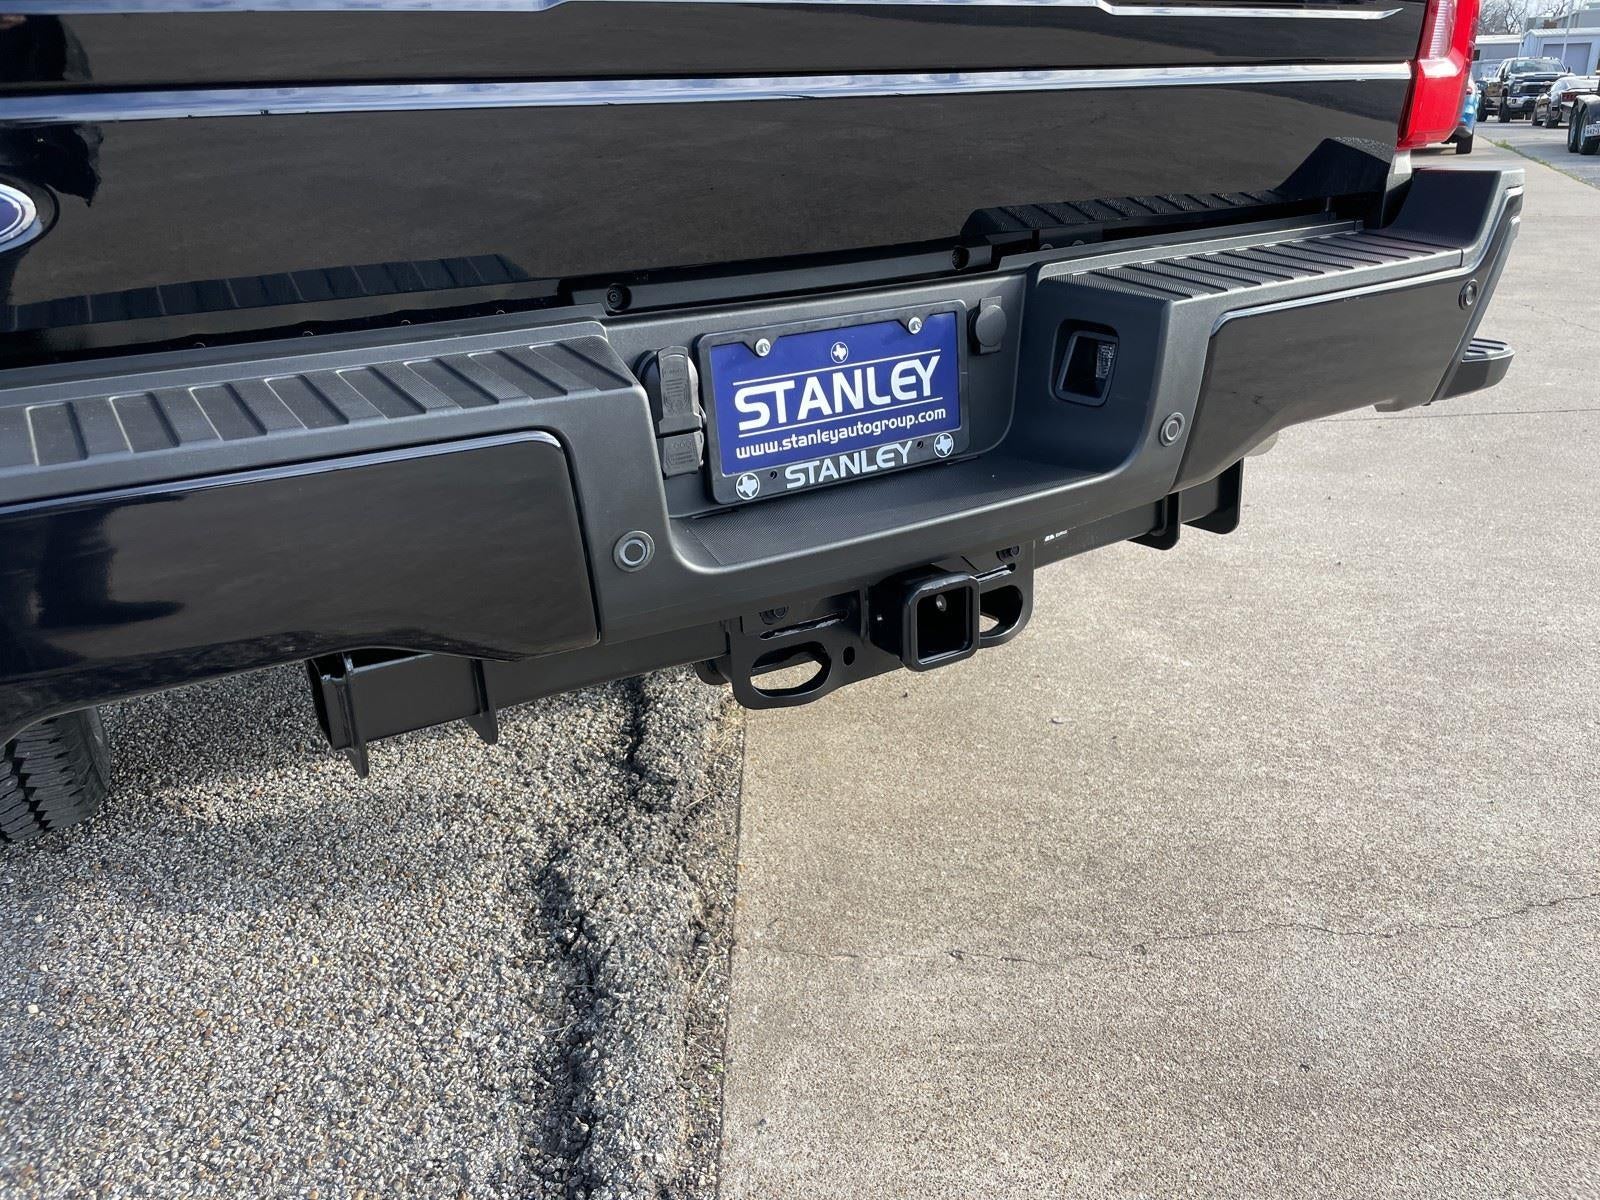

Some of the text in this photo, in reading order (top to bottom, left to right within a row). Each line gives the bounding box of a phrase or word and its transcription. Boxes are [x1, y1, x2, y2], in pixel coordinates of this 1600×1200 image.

[734, 355, 940, 431] STANLEY
[736, 408, 946, 459] www.stanleyautogroup.com
[784, 441, 912, 489] STANLEY
